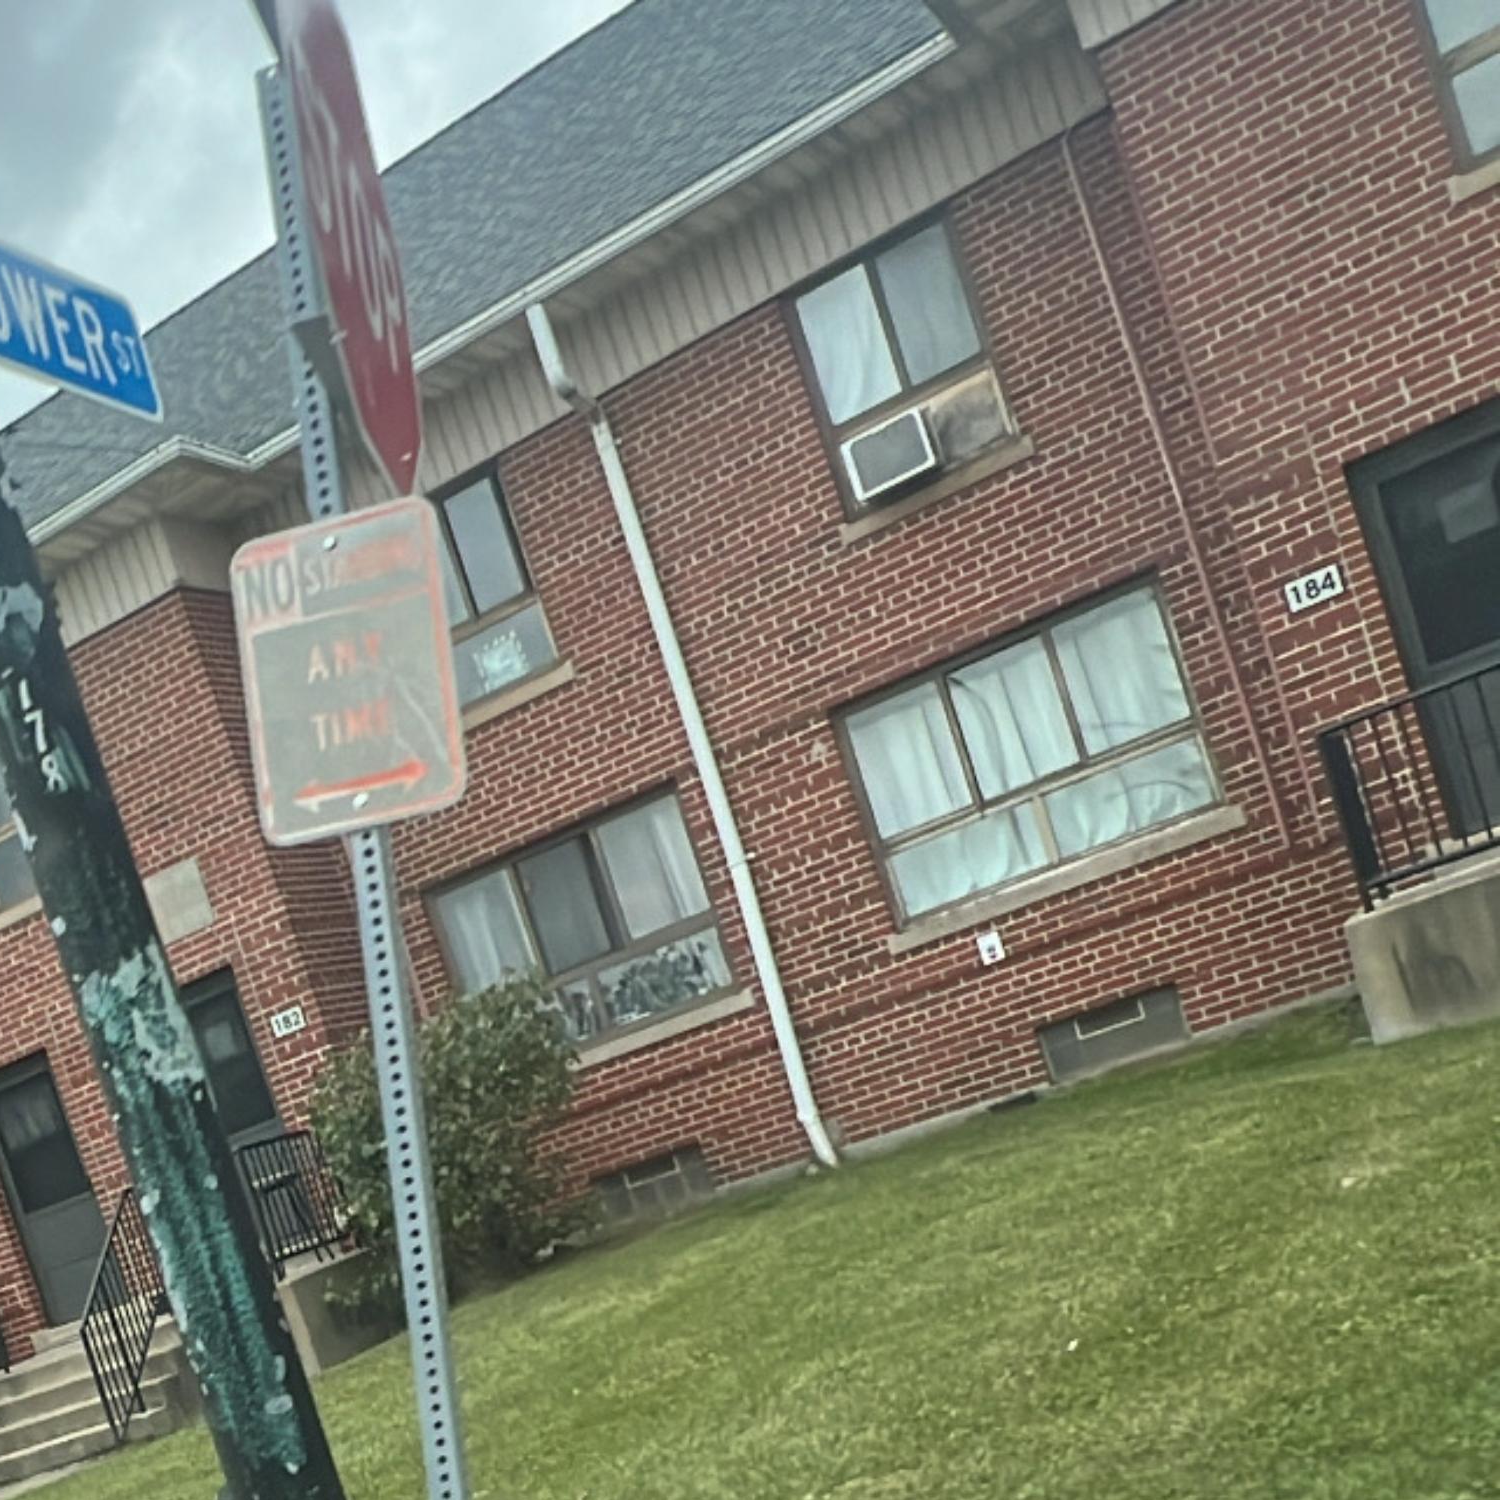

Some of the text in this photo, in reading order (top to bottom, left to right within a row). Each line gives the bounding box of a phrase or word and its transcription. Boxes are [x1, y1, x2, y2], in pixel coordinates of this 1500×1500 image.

[292, 42, 402, 373] STOP
[111, 331, 141, 378] ST
[242, 552, 296, 622] NO
[1289, 571, 1336, 604] 184
[307, 630, 383, 684] ANY
[309, 697, 391, 752] TIME
